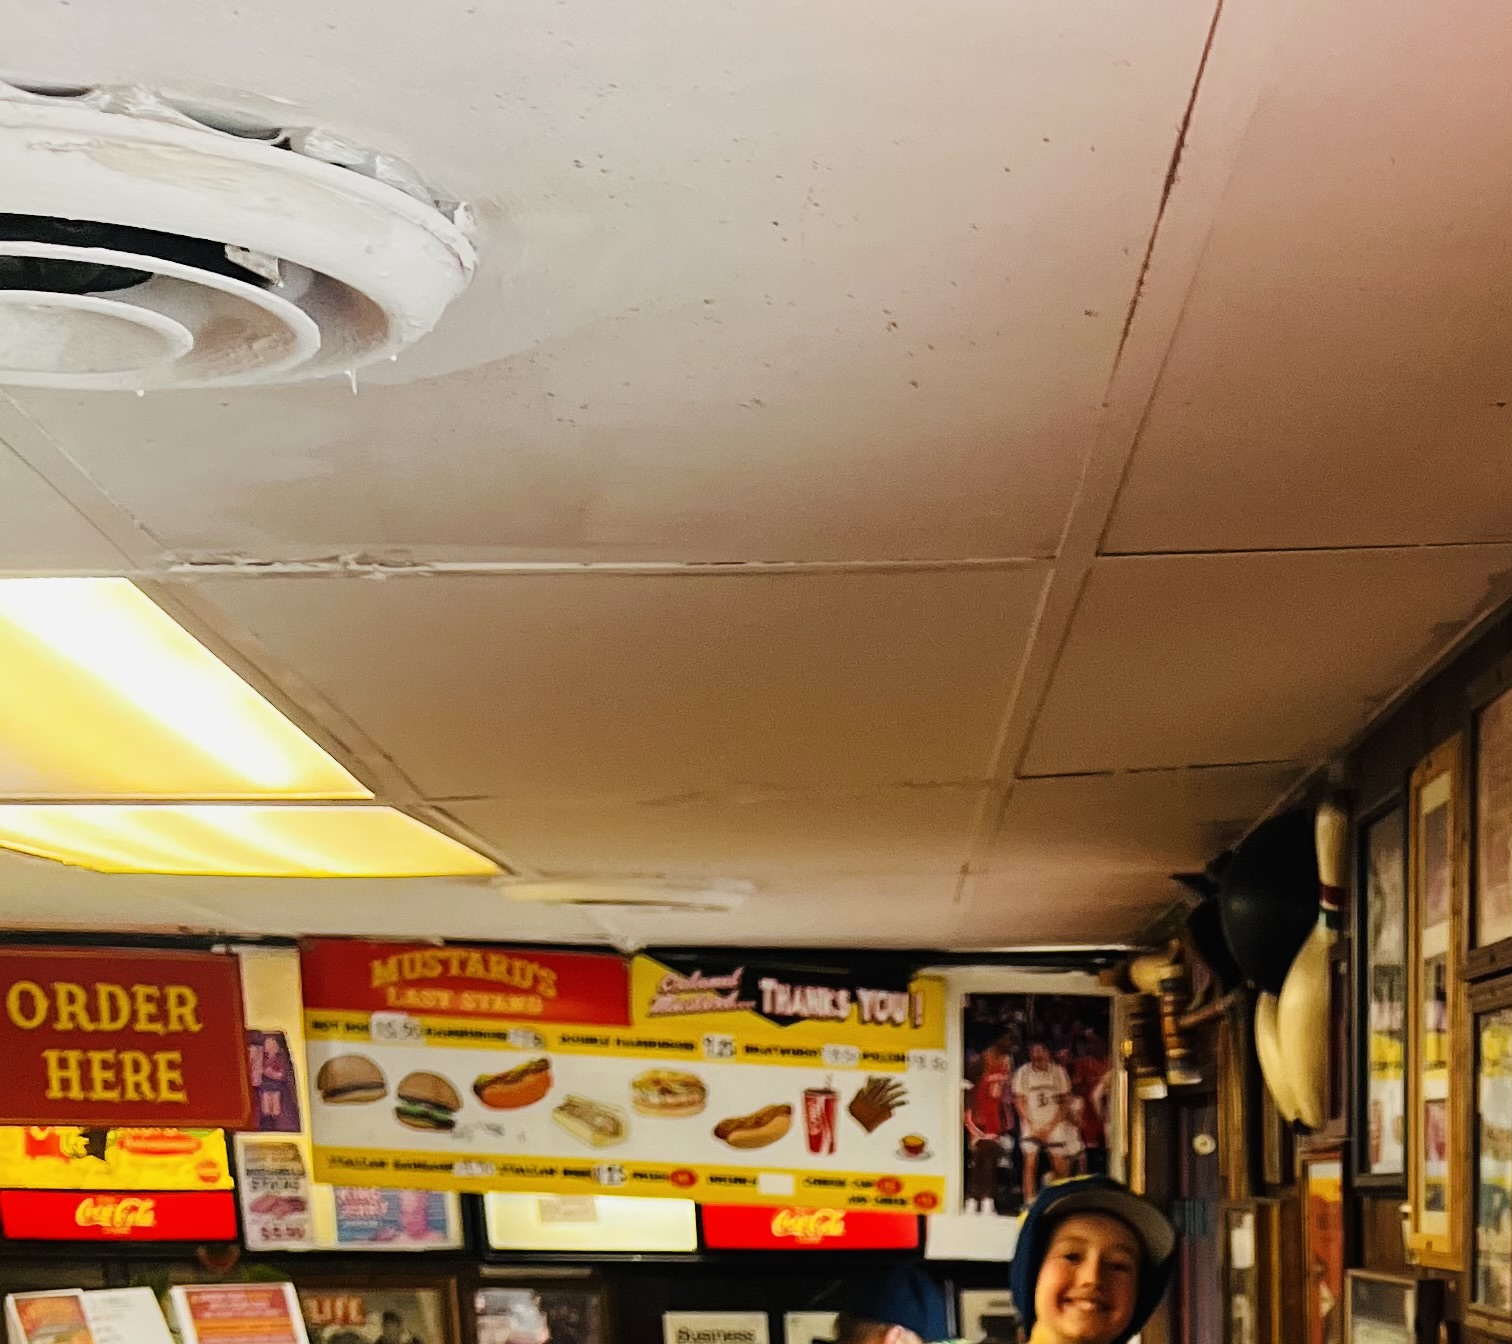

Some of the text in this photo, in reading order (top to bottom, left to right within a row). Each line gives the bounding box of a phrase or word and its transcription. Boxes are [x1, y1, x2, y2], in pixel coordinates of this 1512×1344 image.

[371, 949, 558, 998] MUSTARD'S
[5, 979, 203, 1035] ORDER
[40, 1048, 189, 1104] HERE
